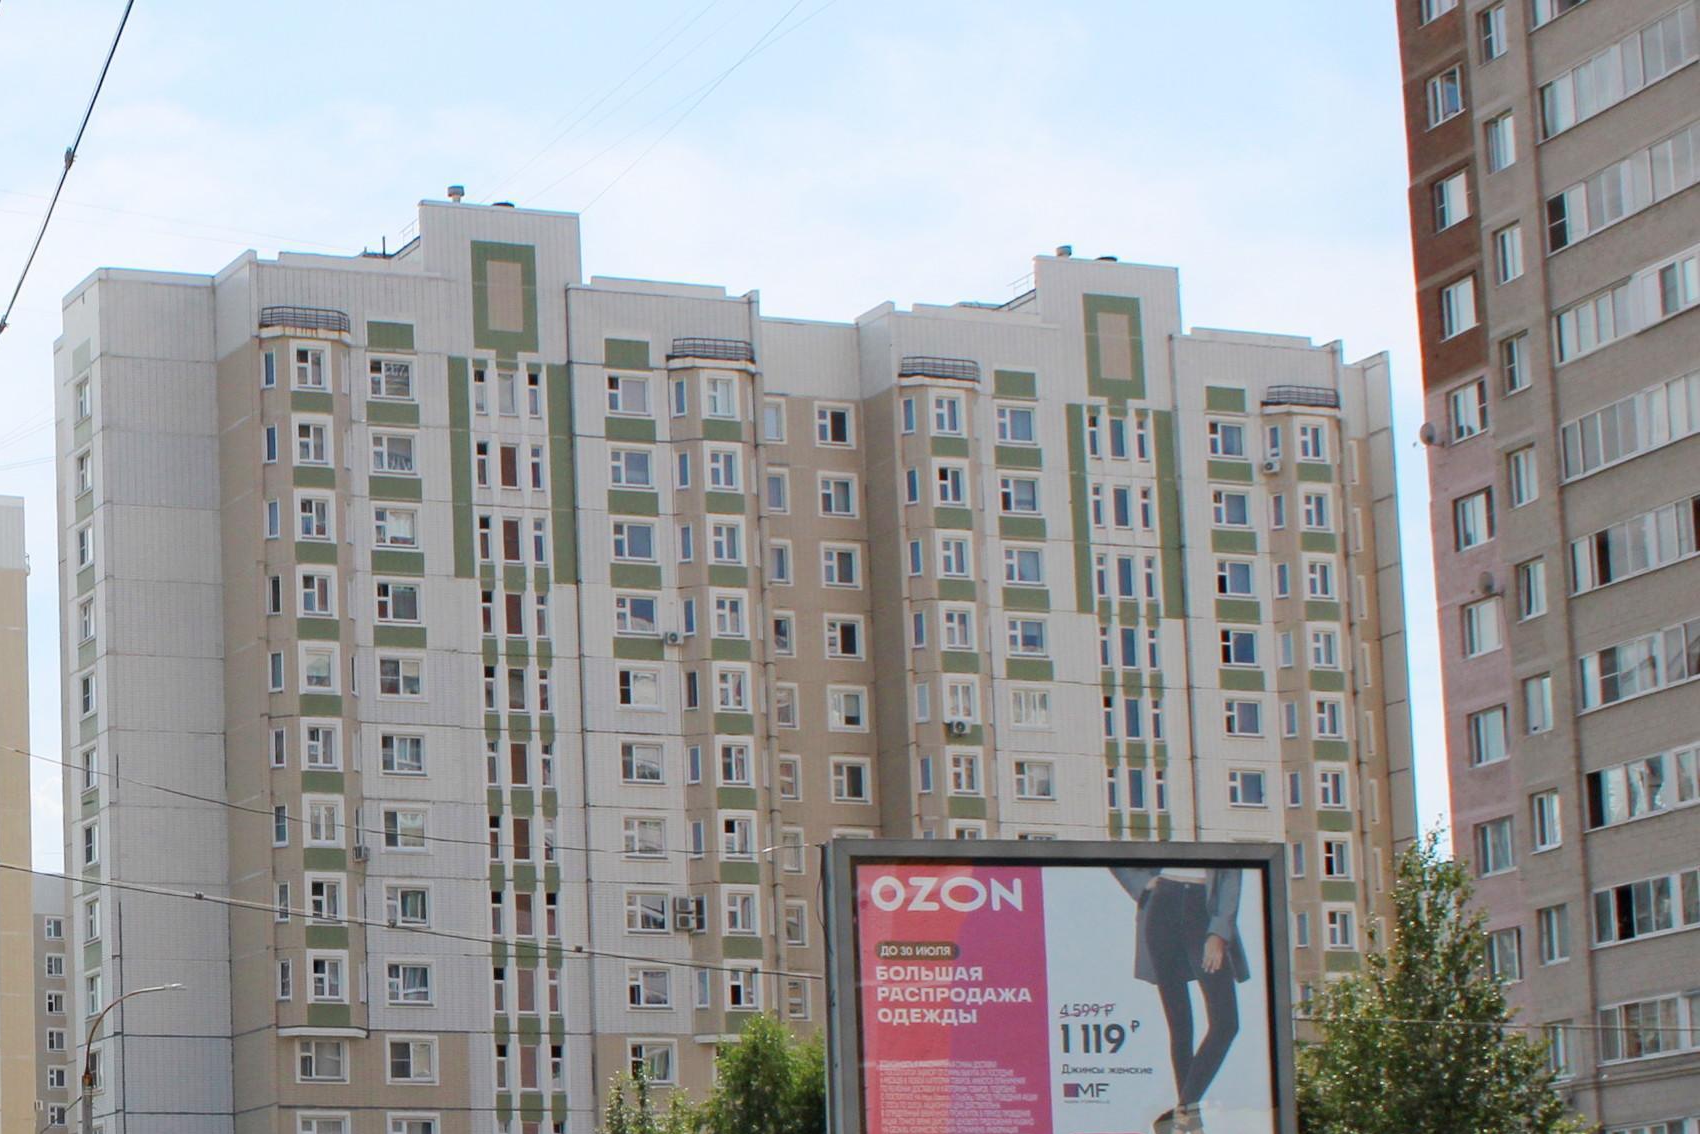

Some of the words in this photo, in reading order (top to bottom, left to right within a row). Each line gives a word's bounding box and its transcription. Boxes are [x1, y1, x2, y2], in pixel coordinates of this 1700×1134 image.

[871, 876, 1024, 912] OZON
[880, 946, 898, 957] ДО
[900, 946, 913, 956] 30
[916, 946, 951, 956] ИЮЛЯ
[876, 966, 983, 981] БОЛЬШАЯ
[877, 987, 1032, 1005] РАСПРОДАЖА
[877, 1008, 978, 1026] ОДЕЖДЫ
[1061, 1064, 1105, 1075] Джинсы
[1108, 1067, 1153, 1075] женские
[1078, 1083, 1110, 1098] MF
